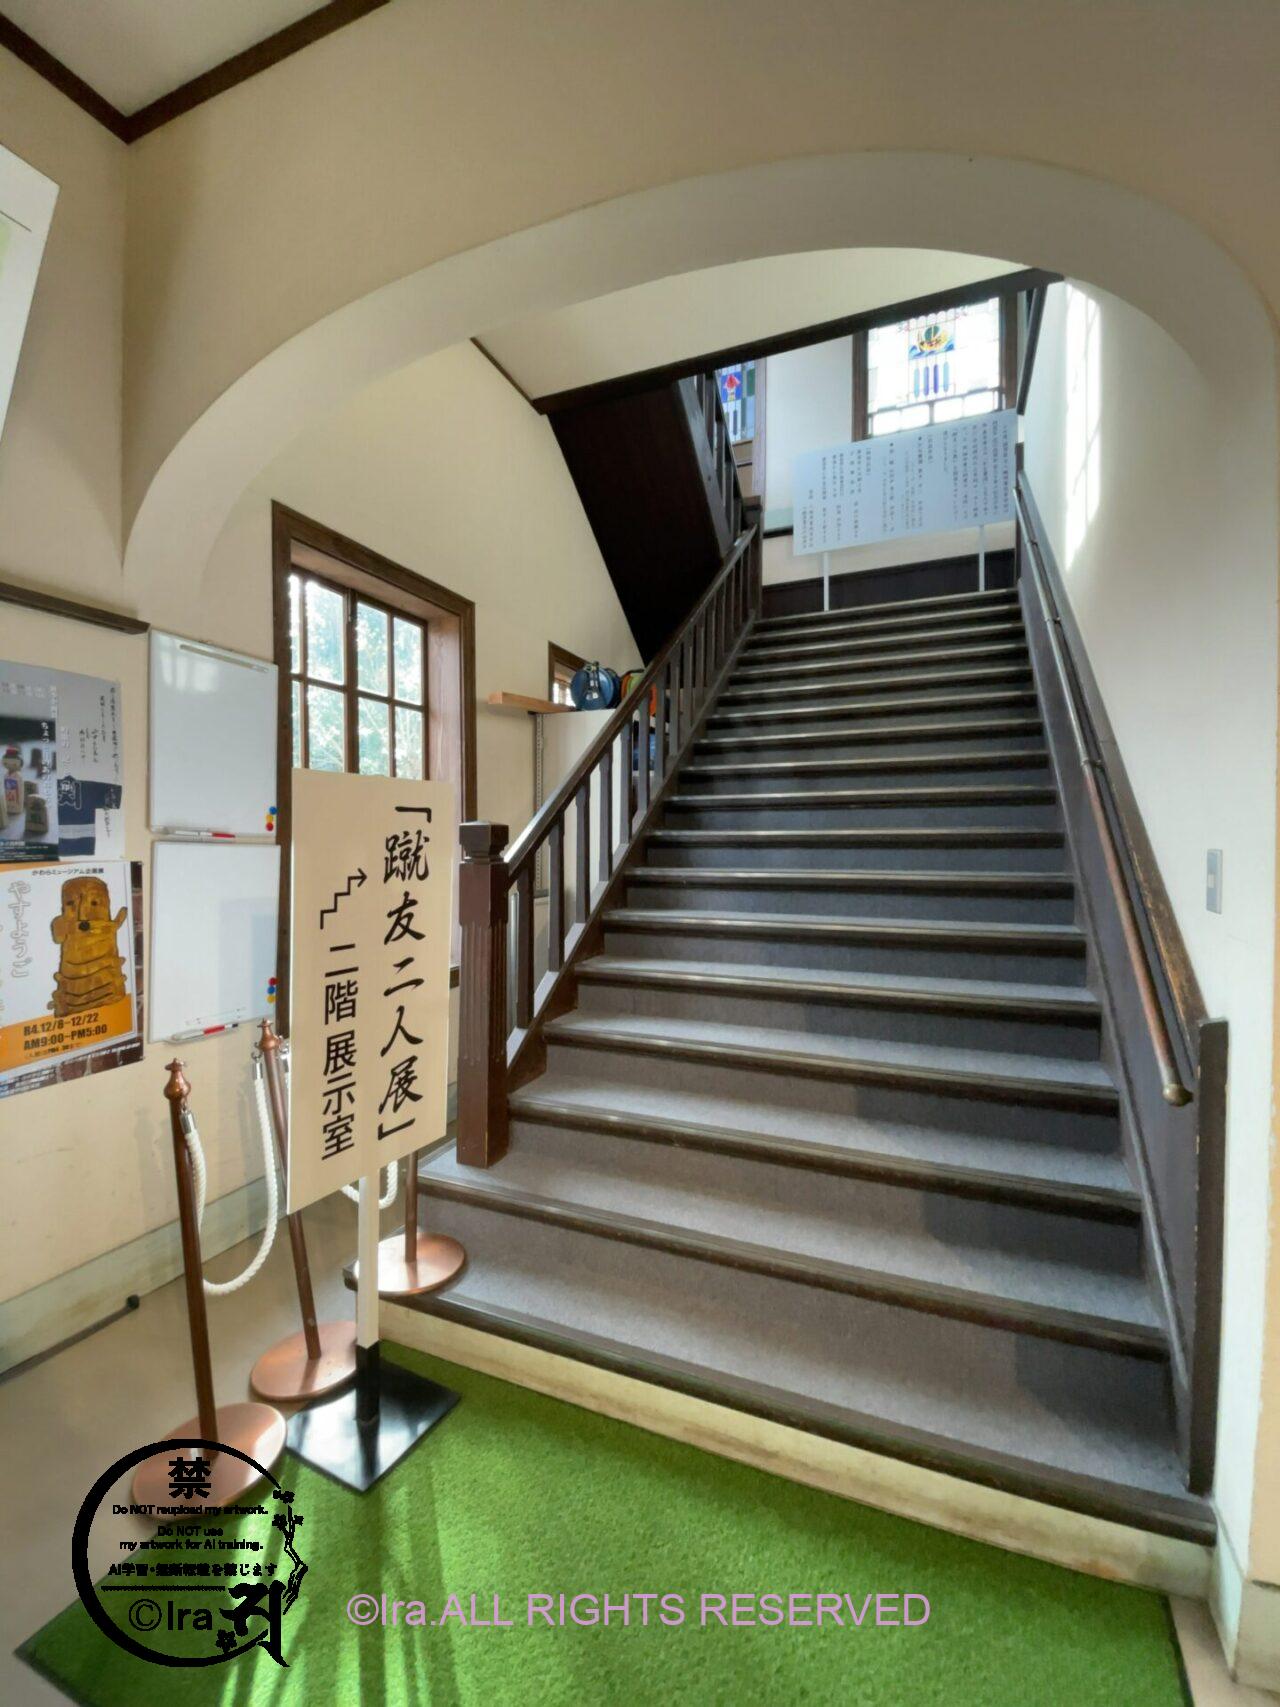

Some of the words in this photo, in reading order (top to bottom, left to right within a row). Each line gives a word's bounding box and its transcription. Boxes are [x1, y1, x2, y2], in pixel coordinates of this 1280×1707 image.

[321, 943, 359, 1161] 二階展示室
[377, 805, 432, 1144] 「蹴友二人展」
